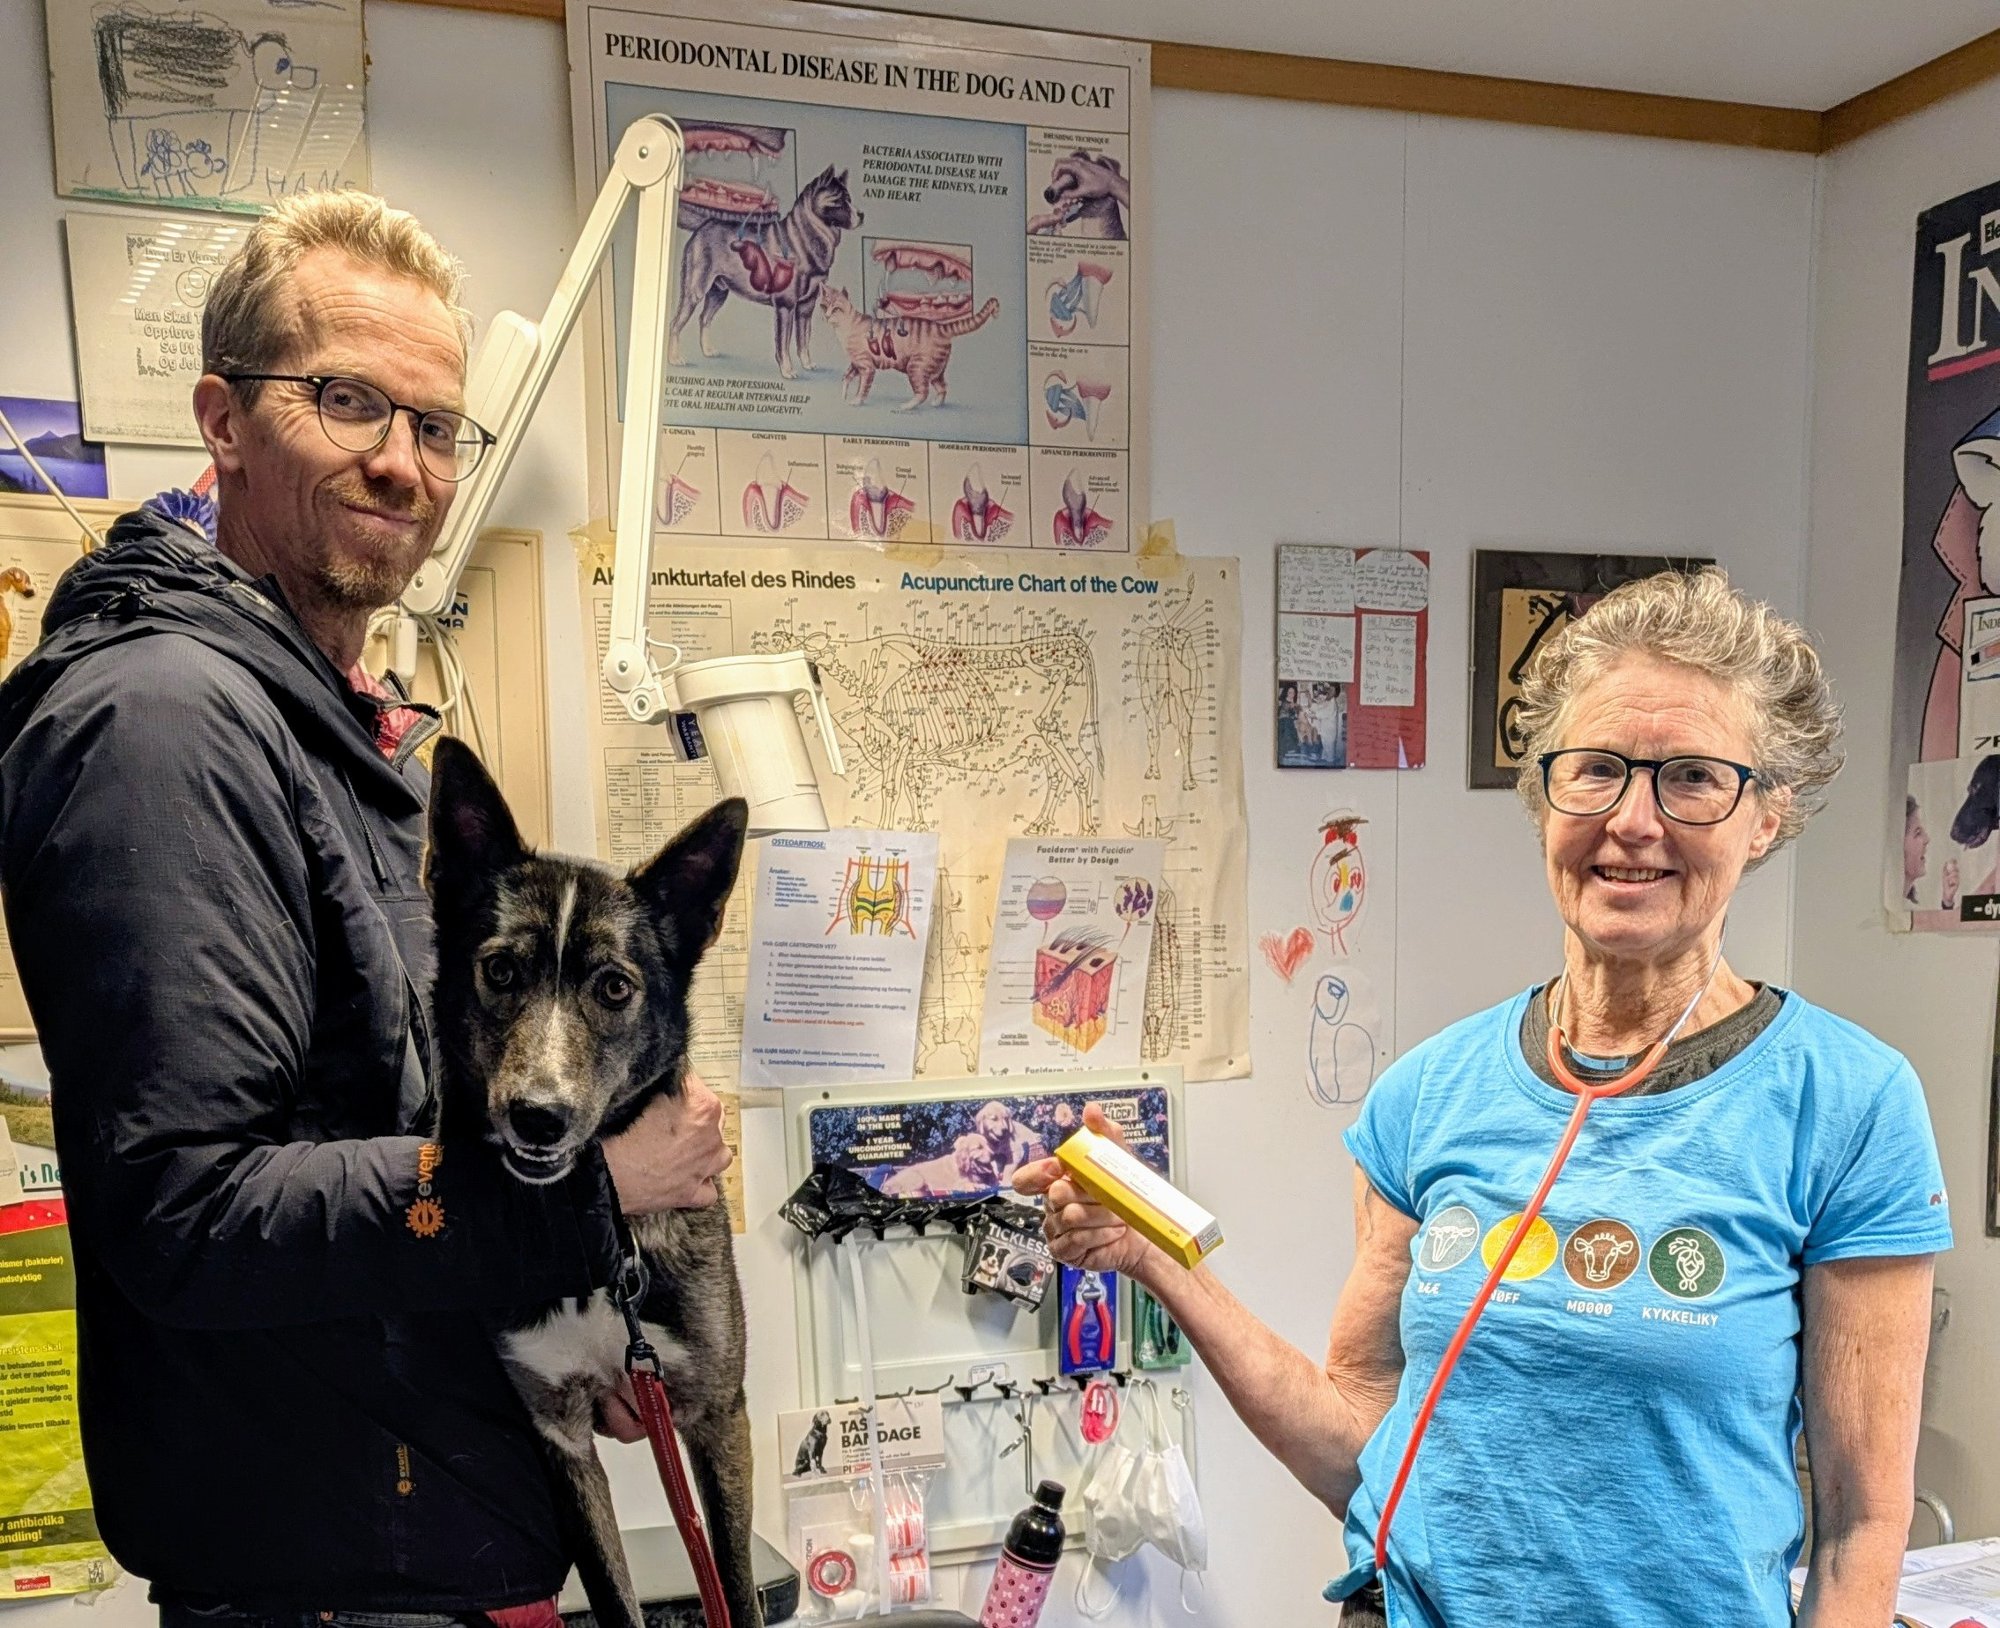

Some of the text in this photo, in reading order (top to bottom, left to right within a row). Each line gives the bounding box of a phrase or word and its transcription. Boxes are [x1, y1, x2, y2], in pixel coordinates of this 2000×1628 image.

[605, 33, 1115, 109] PERIODONTAL DISEASE IN THE DOG AND CAT
[862, 144, 1003, 167] BACTERIA ASSOCIATED WITH
[862, 159, 1000, 181] PERIODONTAL DISEASE MAY
[266, 167, 355, 197] HAN
[863, 173, 1008, 196] DAMAGE THE KIDNEYS, LIVER
[863, 188, 885, 199] AND
[134, 306, 192, 325] Man Skal
[160, 340, 195, 355] Se Ut
[159, 355, 202, 372] Og Job
[707, 378, 725, 387] AND
[726, 379, 786, 391] PROFESSIONAL
[672, 388, 693, 398] CARE
[694, 389, 704, 398] AT
[706, 390, 744, 400] REGULAR
[746, 392, 788, 403] INTERVALS
[789, 394, 811, 404] HELP
[680, 400, 702, 410] ORAL
[704, 401, 736, 412] HEALTH
[737, 403, 755, 413] AND
[668, 428, 696, 436] GINGIVA
[751, 432, 787, 441] GINGIVITIS
[843, 437, 910, 448] EARLY PERIODONTITIS
[938, 443, 1017, 454] MODERATE PERIODONTITIS
[1041, 448, 1117, 459] ADVANCED PERIODONTITIS
[592, 566, 857, 590] Akunkturtafel des Rindes
[900, 571, 1159, 594] Acupuncture Chart of the Cow
[771, 838, 826, 849] OSTEOARTROSE:
[1081, 845, 1099, 853] with
[1048, 855, 1119, 866] Better by Design
[878, 1114, 901, 1122] MADE
[868, 1122, 883, 1130] THE
[885, 1121, 901, 1129] USA
[1122, 1122, 1145, 1130] OLLAR
[872, 1136, 894, 1144] YEAR
[848, 1143, 912, 1154] UNCONDITIONAL
[857, 1150, 904, 1161] GUARANTEE
[418, 1143, 435, 1196] event
[25, 1256, 64, 1268] (bakterier)
[1642, 1307, 1719, 1327] KYKKELIKY
[42, 1341, 62, 1353] skal
[7, 1358, 63, 1370] behandles med
[9, 1371, 22, 1379] det
[33, 1368, 71, 1379] nødvendig
[32, 1395, 62, 1404] mengde
[63, 1394, 73, 1402] og
[17, 1421, 44, 1430] leveres
[45, 1419, 71, 1428] tilbake
[839, 1418, 885, 1434] TAS-
[7, 1515, 65, 1530] antibiotika
